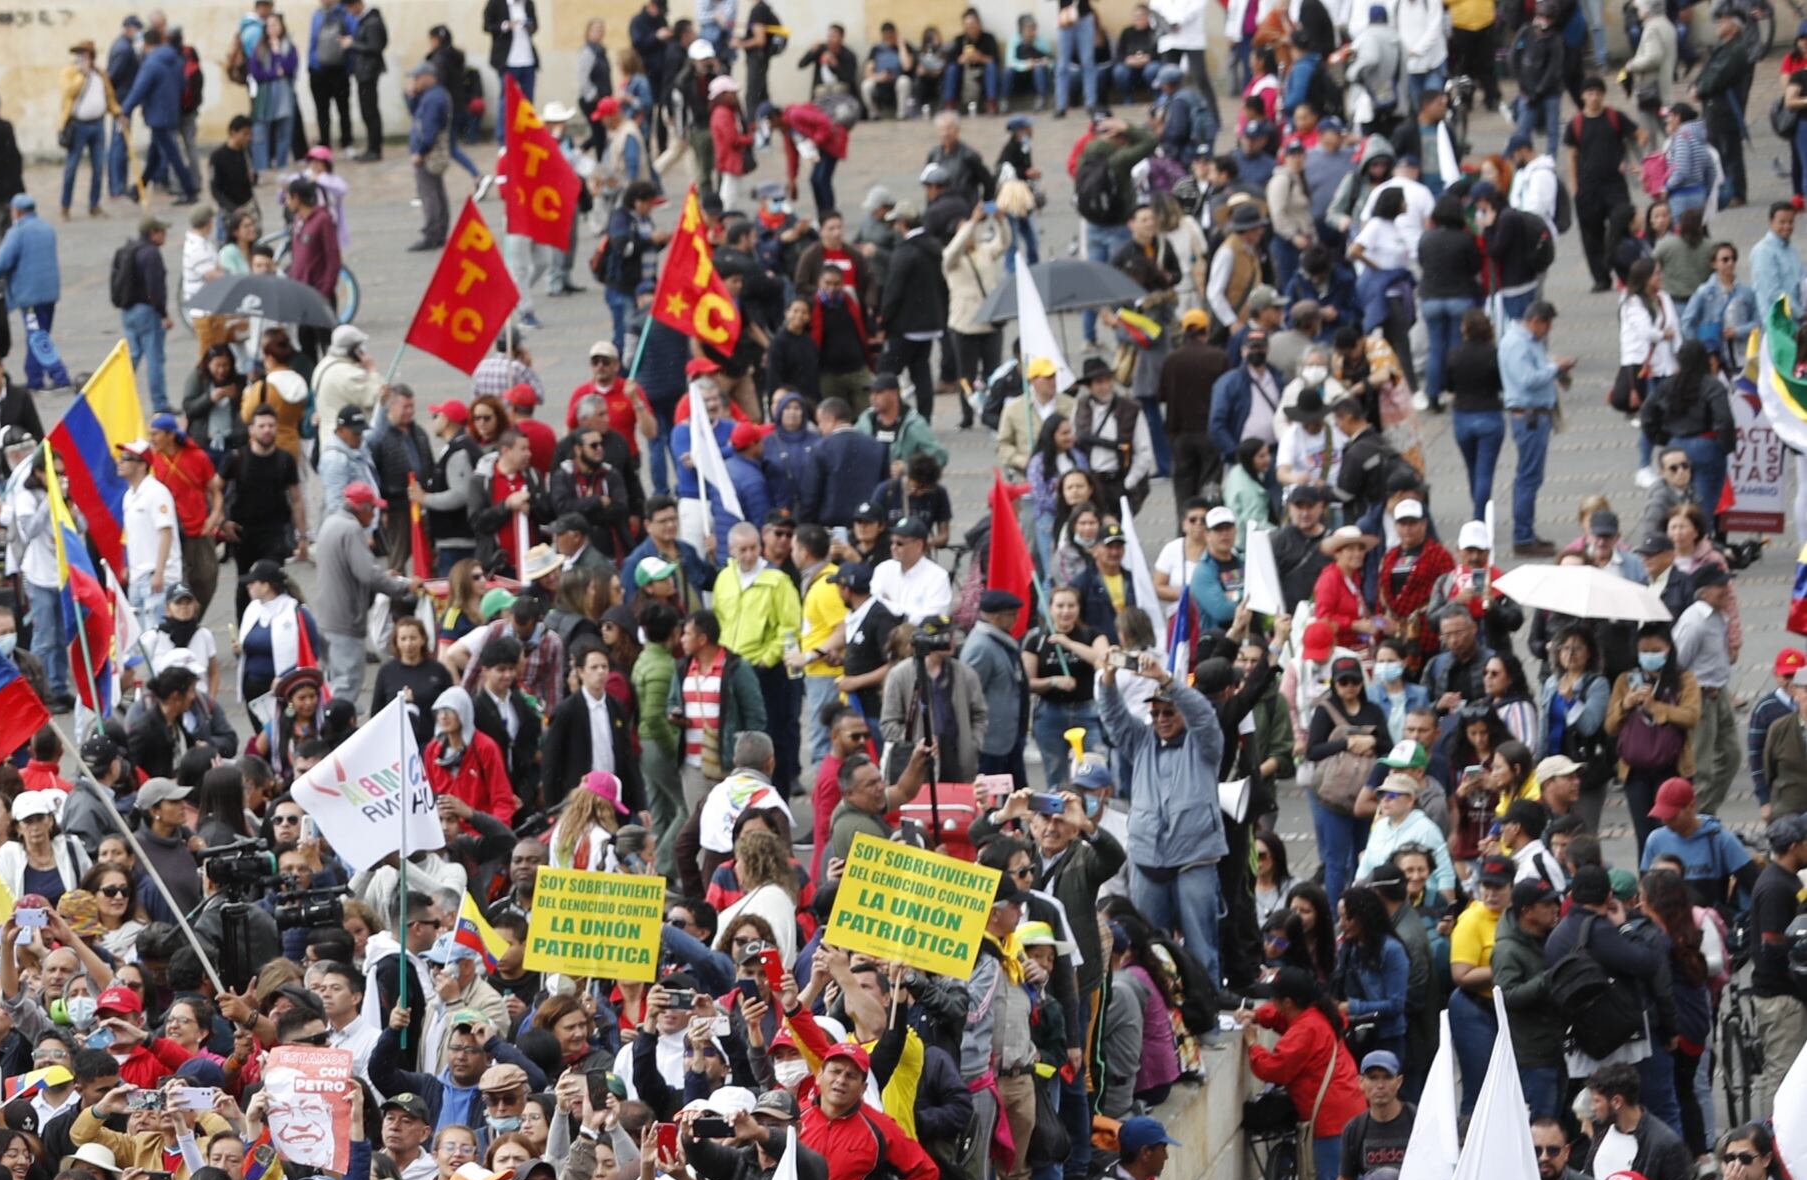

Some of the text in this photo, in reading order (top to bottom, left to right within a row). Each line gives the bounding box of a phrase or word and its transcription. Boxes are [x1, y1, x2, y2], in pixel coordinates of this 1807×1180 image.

[451, 219, 494, 343] PTC
[1735, 447, 1779, 463] VIS
[1732, 465, 1778, 482] TAS
[854, 842, 995, 894] SOY SOBREVIVIENTE
[540, 875, 662, 900] SOY SOBREVIVIENTE
[849, 864, 986, 913] DEL GENOCIDIO CONTRA
[538, 896, 658, 918] DEL GENOCIDIO CONTRA
[858, 888, 963, 932] LA UNIÓN
[550, 916, 641, 939] LA UNIÓN
[836, 910, 969, 961] PATRIÓTICA
[533, 937, 650, 964] PATRIÓTICA
[280, 1051, 350, 1065] ESTAMOS
[319, 1067, 348, 1077] CON
[296, 1080, 346, 1092] PETRO
[1367, 1147, 1404, 1165] adida
